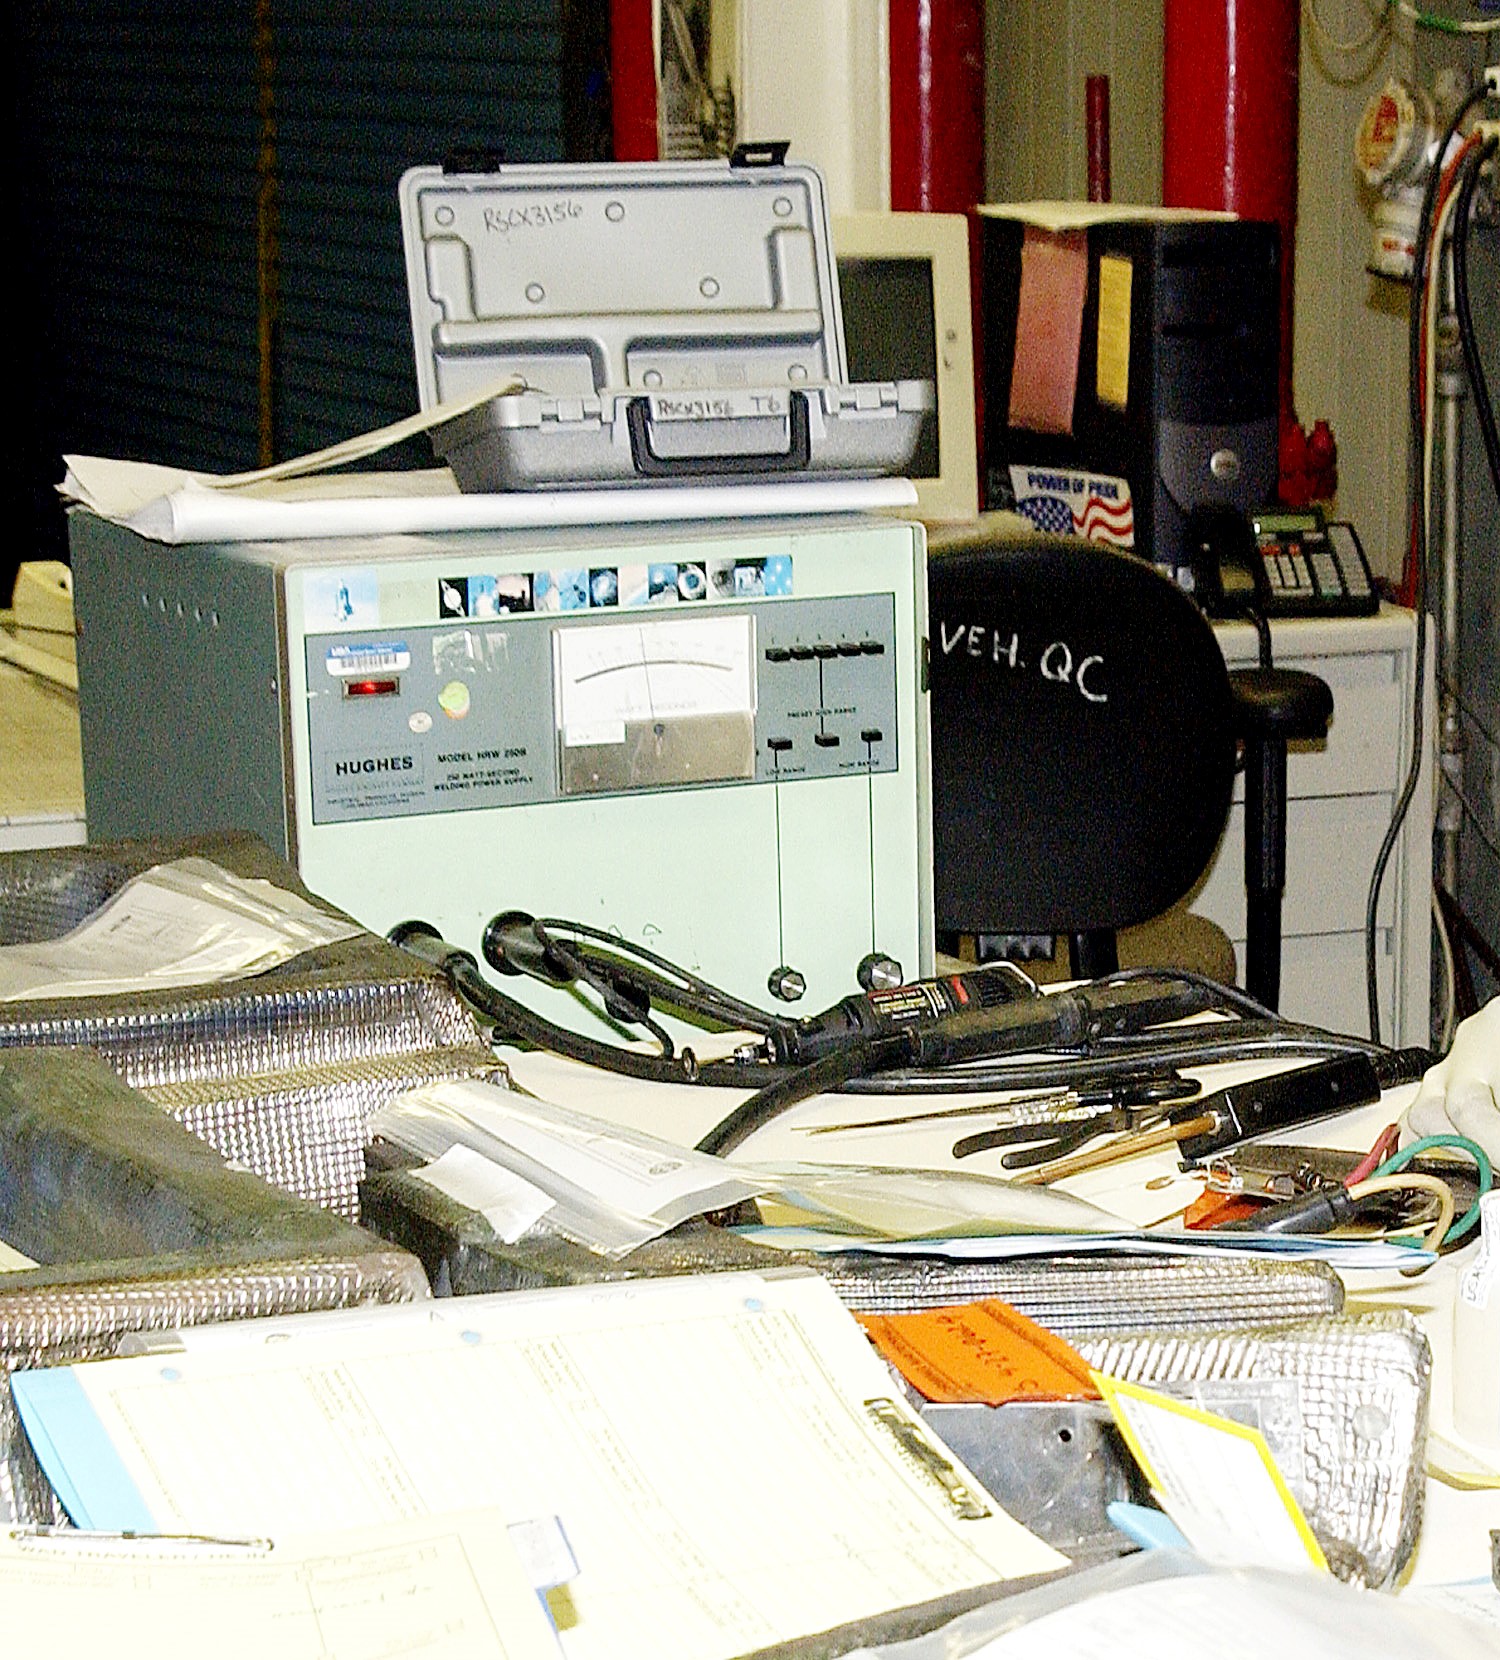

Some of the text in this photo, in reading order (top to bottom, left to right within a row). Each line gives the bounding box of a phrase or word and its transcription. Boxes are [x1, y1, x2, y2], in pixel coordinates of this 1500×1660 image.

[1027, 472, 1118, 501] POWER OF PRIDE
[940, 620, 1108, 702] VEH. QC
[335, 755, 414, 776] HUGHES
[437, 752, 473, 763] MODEL
[473, 778, 501, 787] POWER
